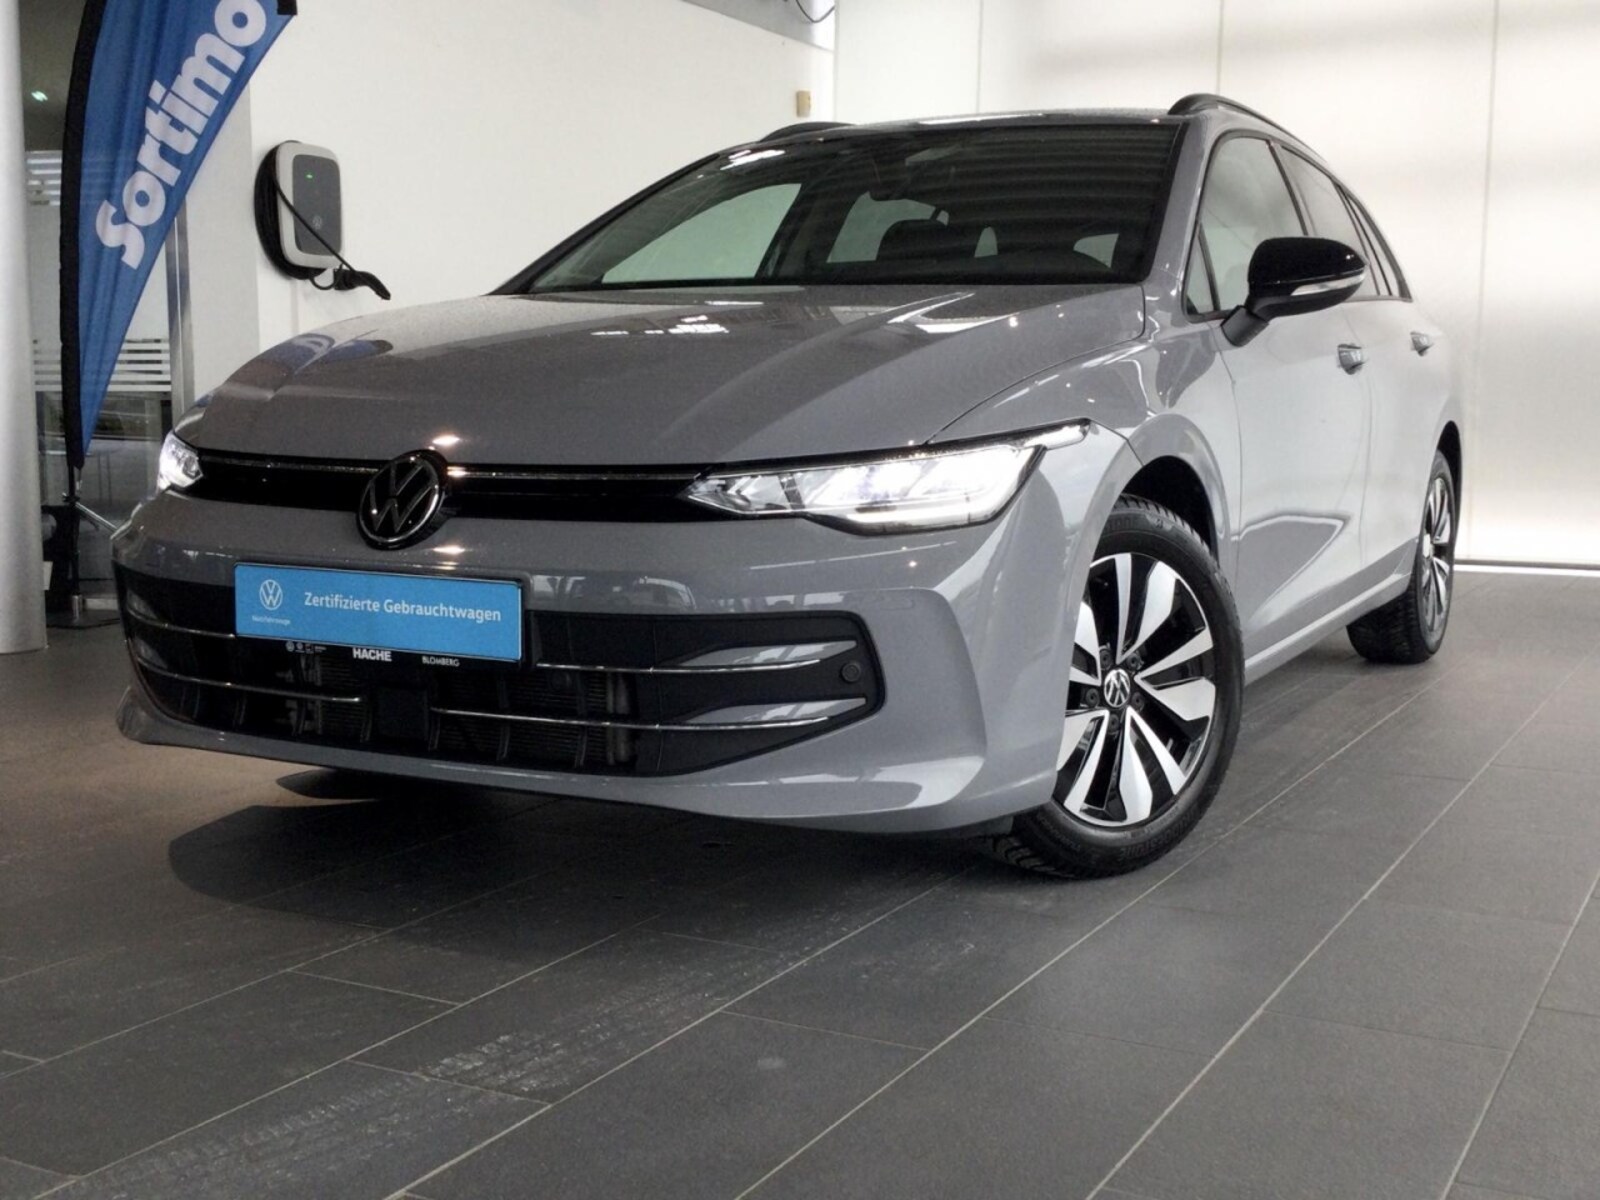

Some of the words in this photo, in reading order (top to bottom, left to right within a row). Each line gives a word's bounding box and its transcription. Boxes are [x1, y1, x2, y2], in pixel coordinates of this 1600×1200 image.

[96, 0, 267, 270] Sortimo
[259, 579, 283, 610] VW
[304, 592, 380, 612] Zertifizierte
[384, 599, 501, 624] Gebrauchtwagen
[352, 648, 392, 662] HACHE
